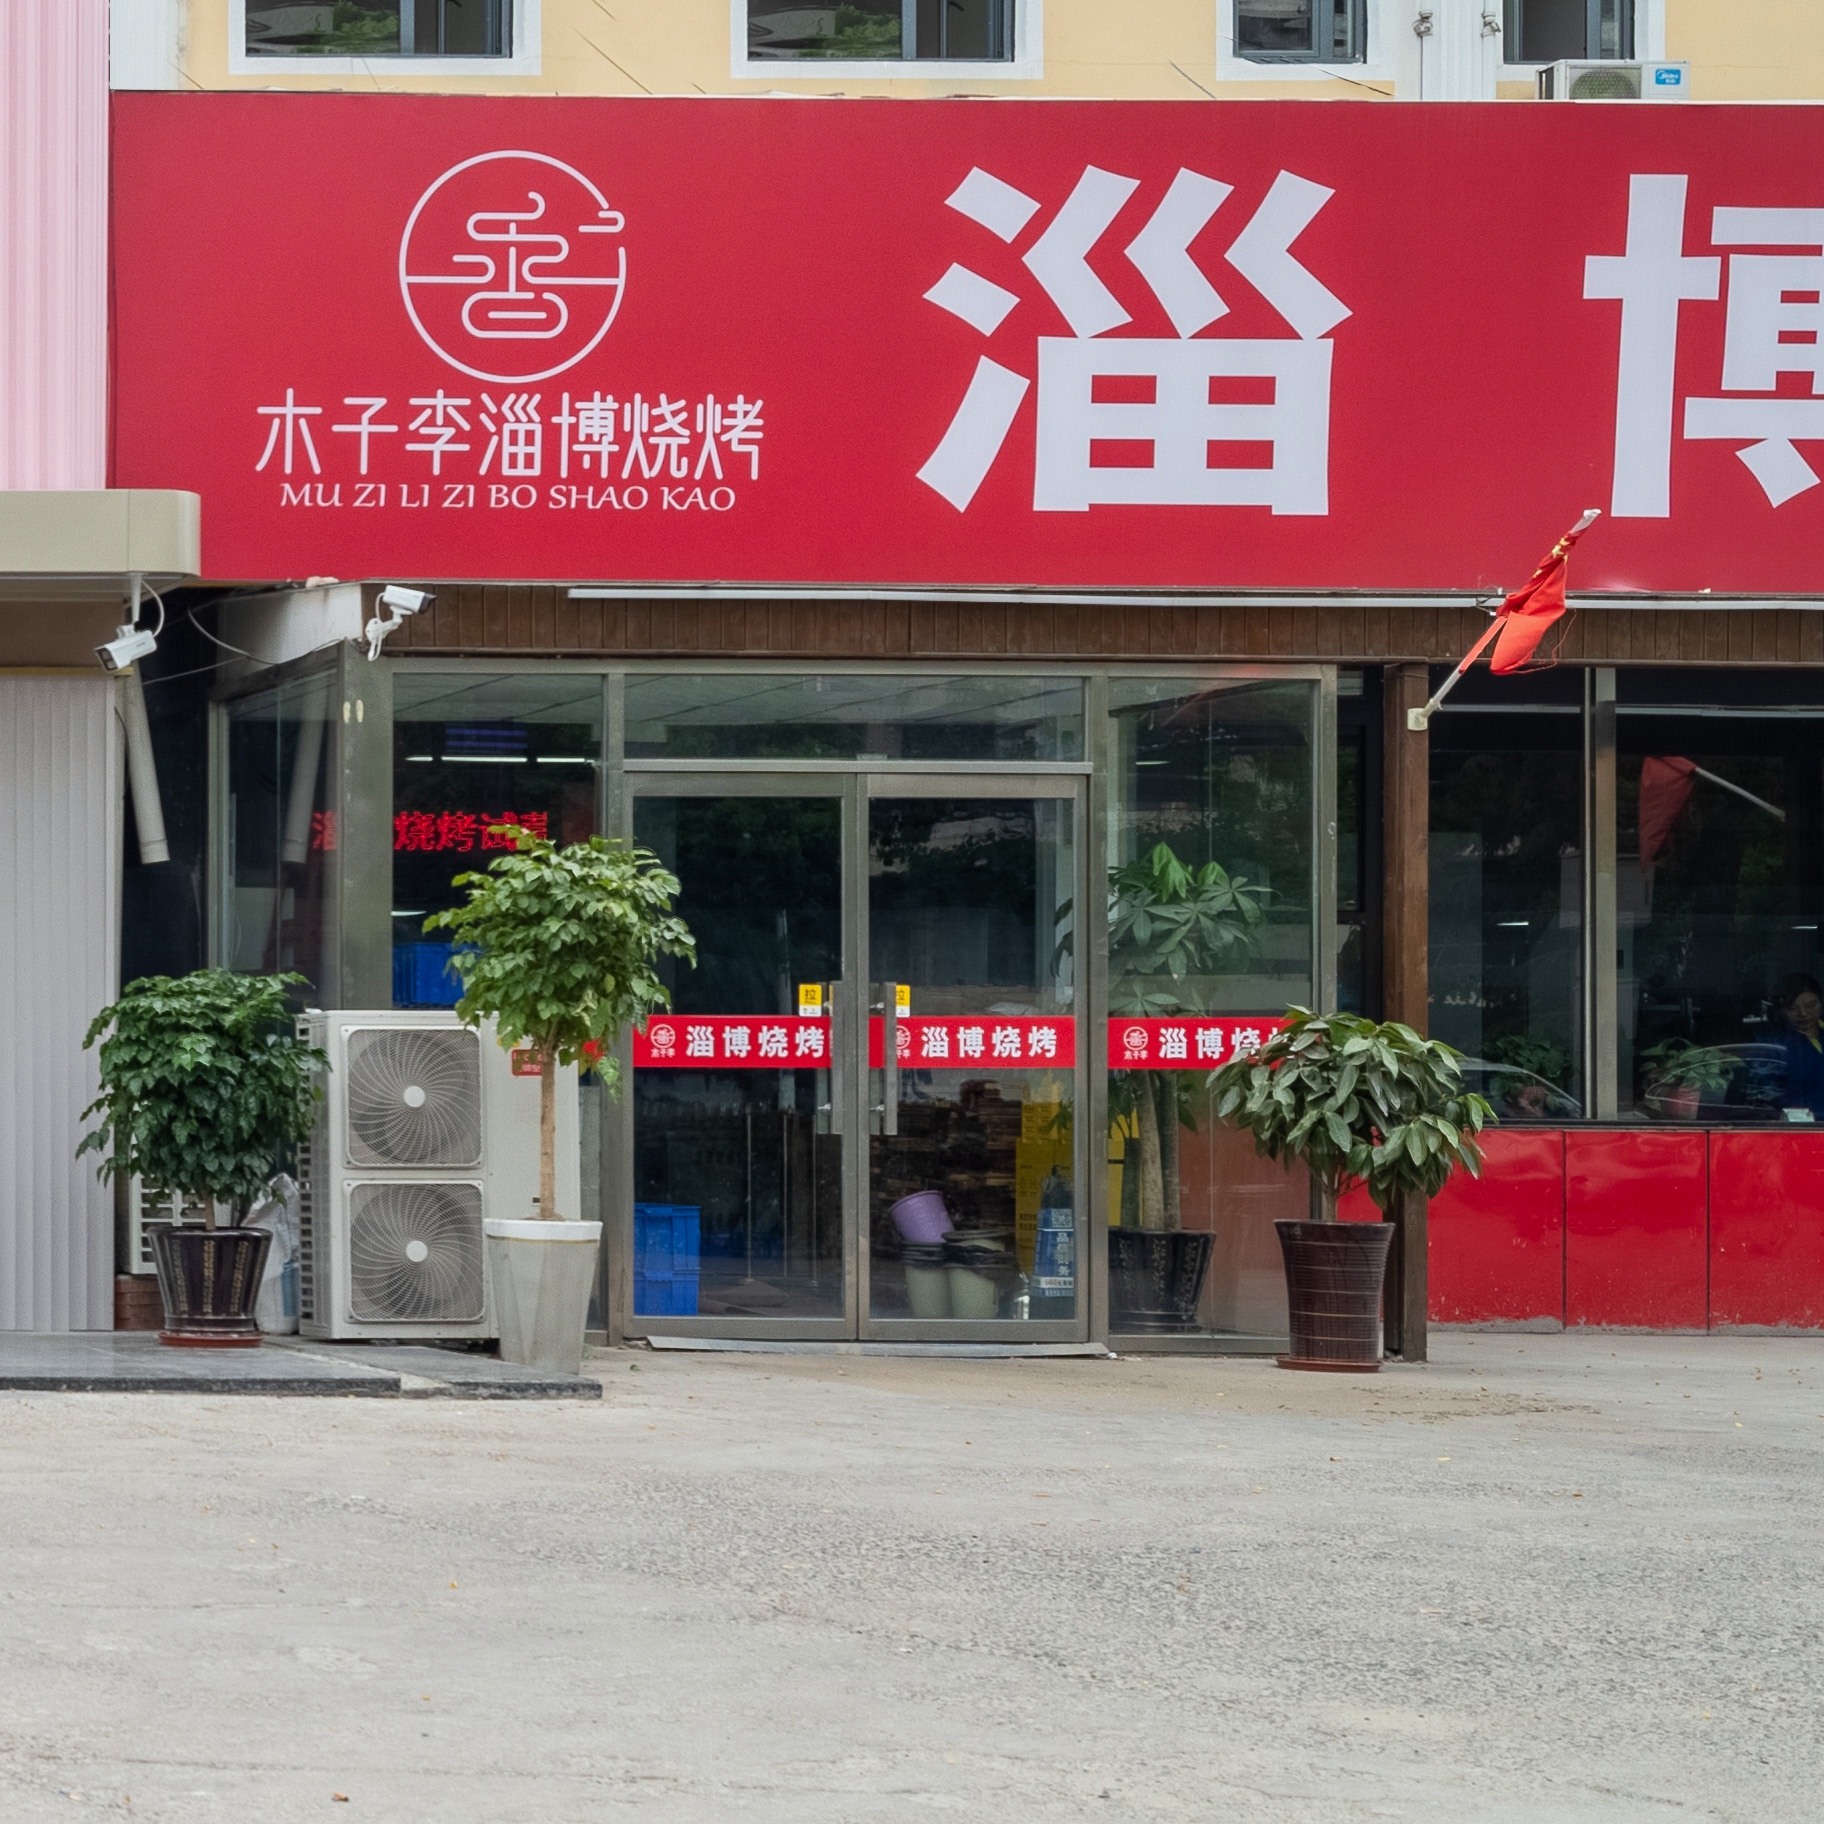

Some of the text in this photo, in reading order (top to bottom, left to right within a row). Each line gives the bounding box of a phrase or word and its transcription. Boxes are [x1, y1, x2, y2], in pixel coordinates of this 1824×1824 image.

[255, 387, 763, 480] 木子李淄博烧烤
[280, 482, 736, 511] MU ZI LI ZI BO SHAO KAO
[685, 1025, 825, 1058] 淄博烧烤
[920, 1025, 1057, 1058] 淄博烧烤
